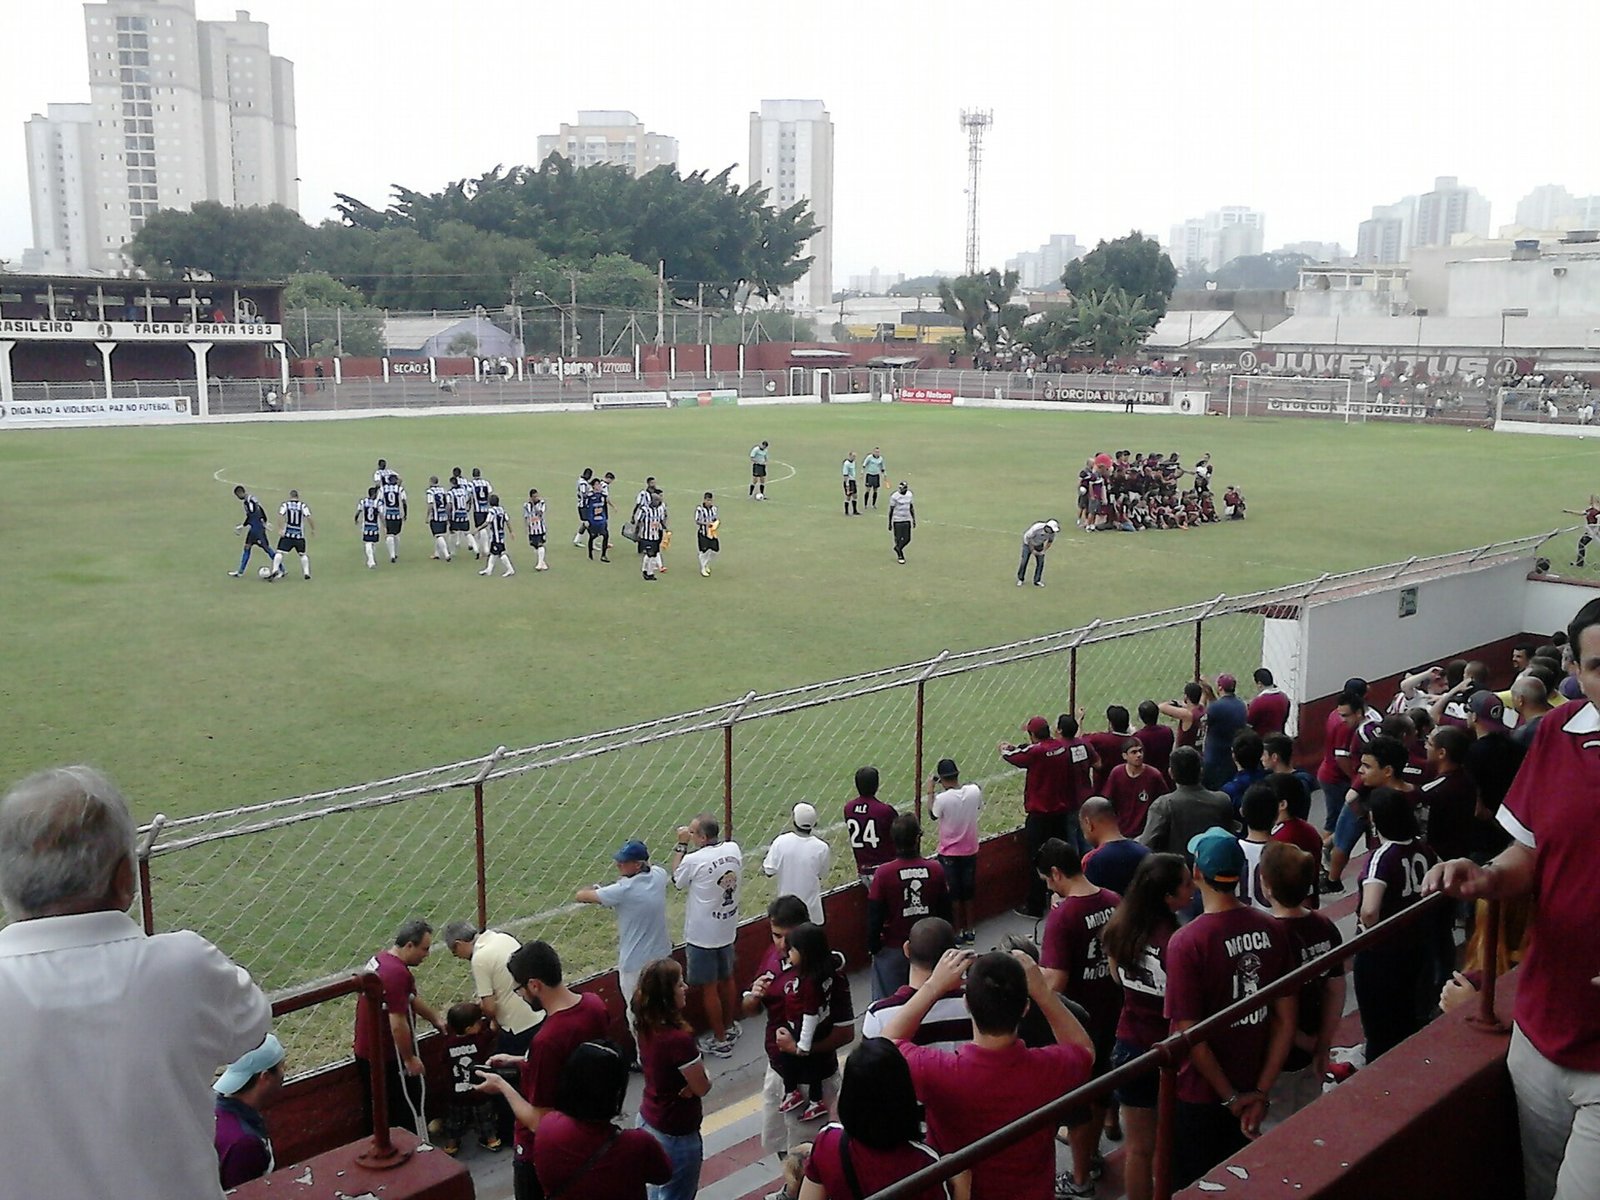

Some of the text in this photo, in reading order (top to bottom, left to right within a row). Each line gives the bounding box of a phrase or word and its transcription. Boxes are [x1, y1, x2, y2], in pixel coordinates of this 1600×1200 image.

[0, 321, 73, 333] ASILEIRO
[174, 324, 190, 334] DE
[194, 324, 236, 335] PRATA
[239, 325, 273, 335] 1983
[422, 363, 429, 374] 3
[1260, 353, 1490, 377] JUVENTUS
[1055, 389, 1102, 400] TORCIDA
[11, 406, 32, 415] DIGA
[388, 492, 396, 506] 9
[290, 509, 300, 525] 11
[367, 507, 375, 521] 8
[847, 818, 880, 848] 24
[1402, 852, 1428, 897] 10
[1225, 931, 1272, 957] MOOCA
